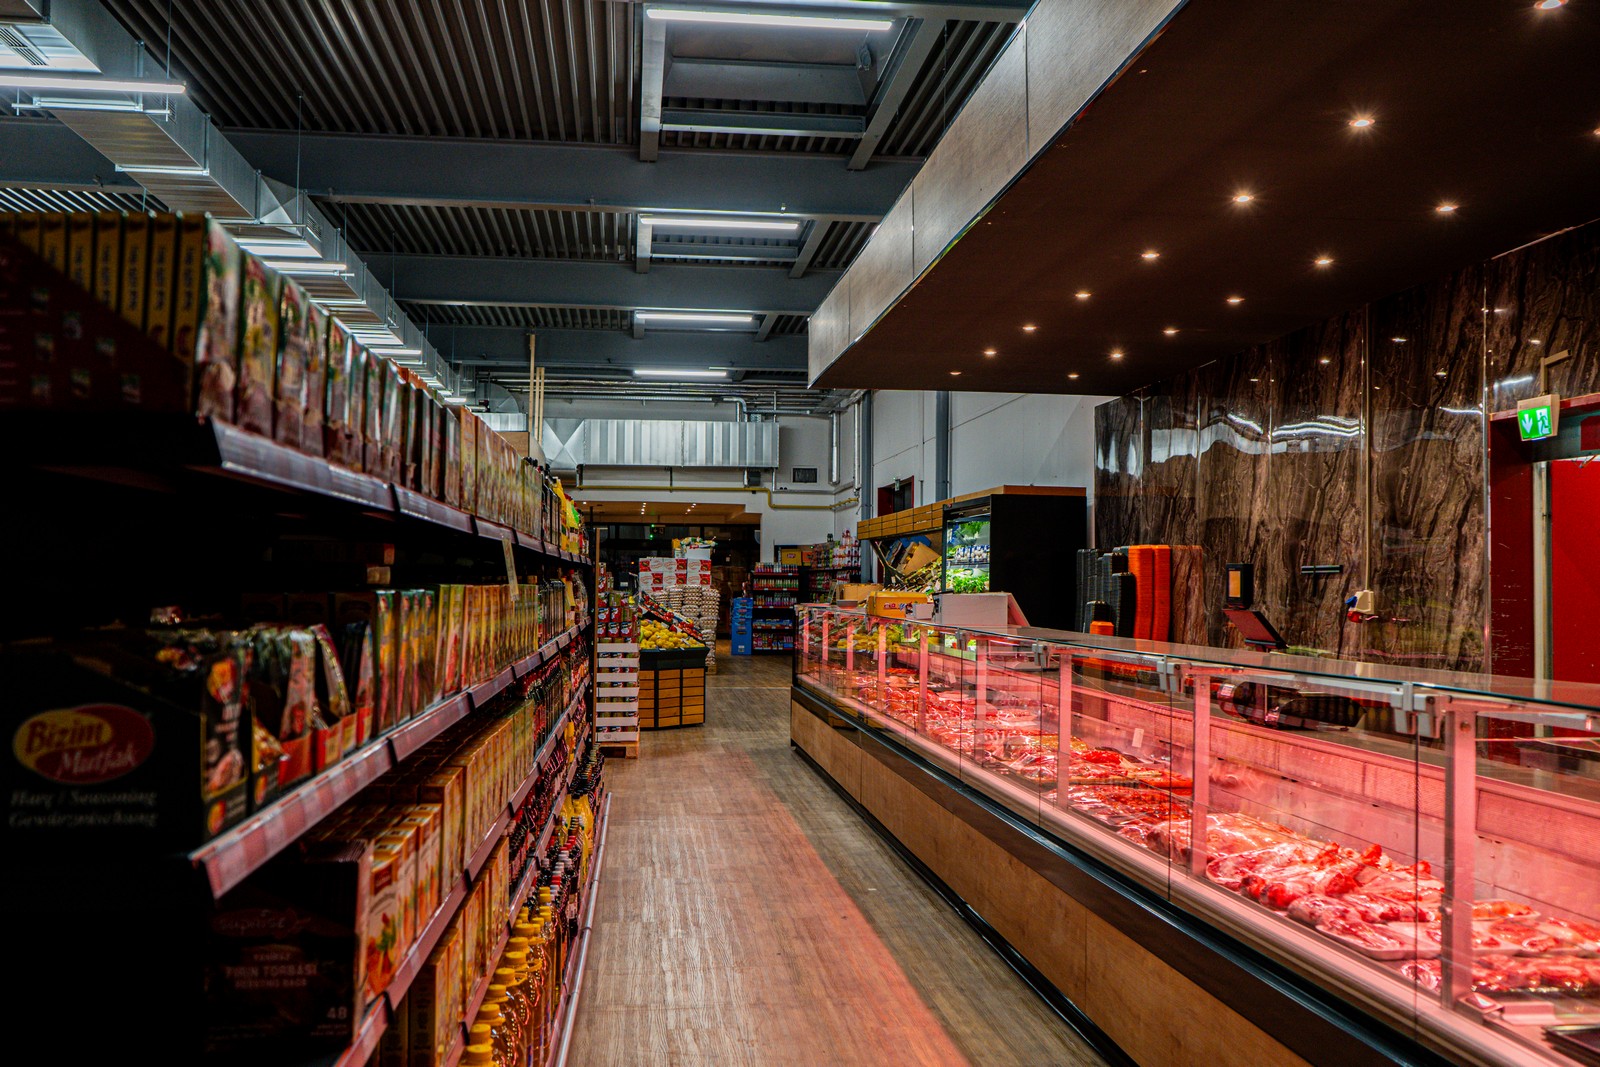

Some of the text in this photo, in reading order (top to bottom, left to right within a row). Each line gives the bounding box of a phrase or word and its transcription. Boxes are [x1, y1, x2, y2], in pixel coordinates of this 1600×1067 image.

[25, 717, 104, 754] Bizim
[56, 740, 137, 779] Mutfak
[326, 1006, 349, 1020] 48
